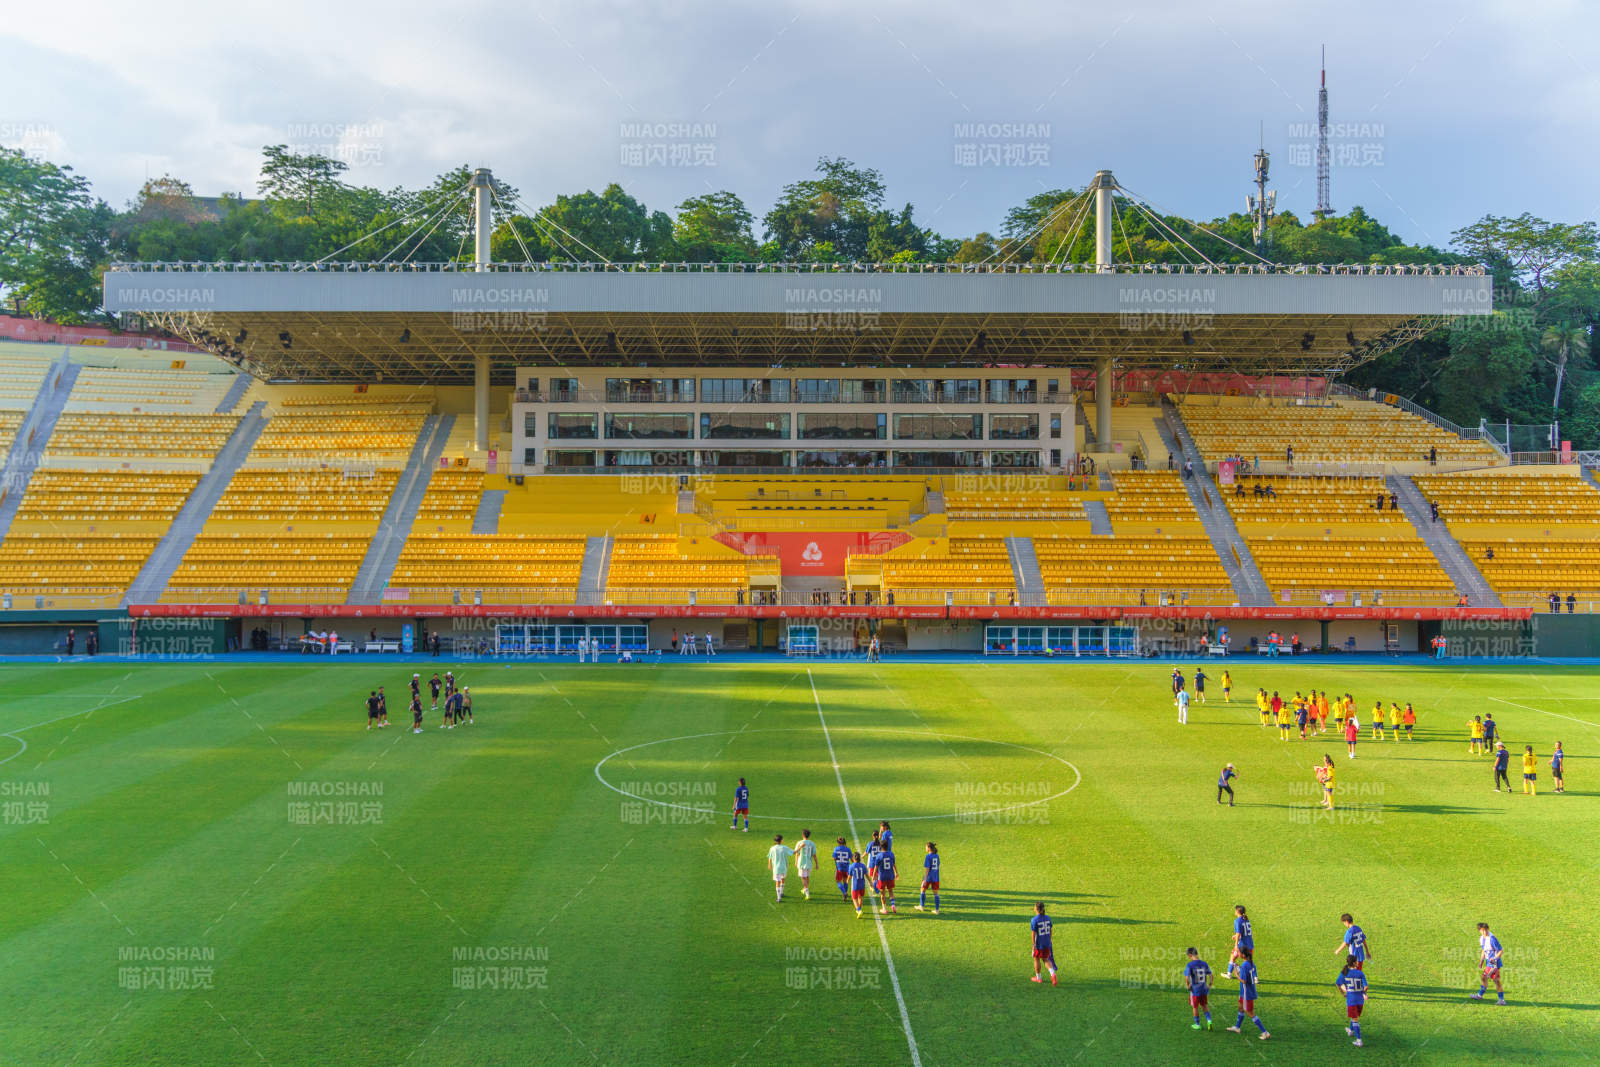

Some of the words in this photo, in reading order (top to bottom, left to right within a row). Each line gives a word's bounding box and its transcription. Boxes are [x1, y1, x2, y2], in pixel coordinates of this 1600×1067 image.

[741, 789, 747, 800] 5
[836, 851, 849, 863] 32
[883, 857, 891, 870] 6
[931, 858, 938, 870] 9
[854, 867, 863, 879] 11
[1037, 920, 1050, 936] 26
[1345, 977, 1363, 992] 20
